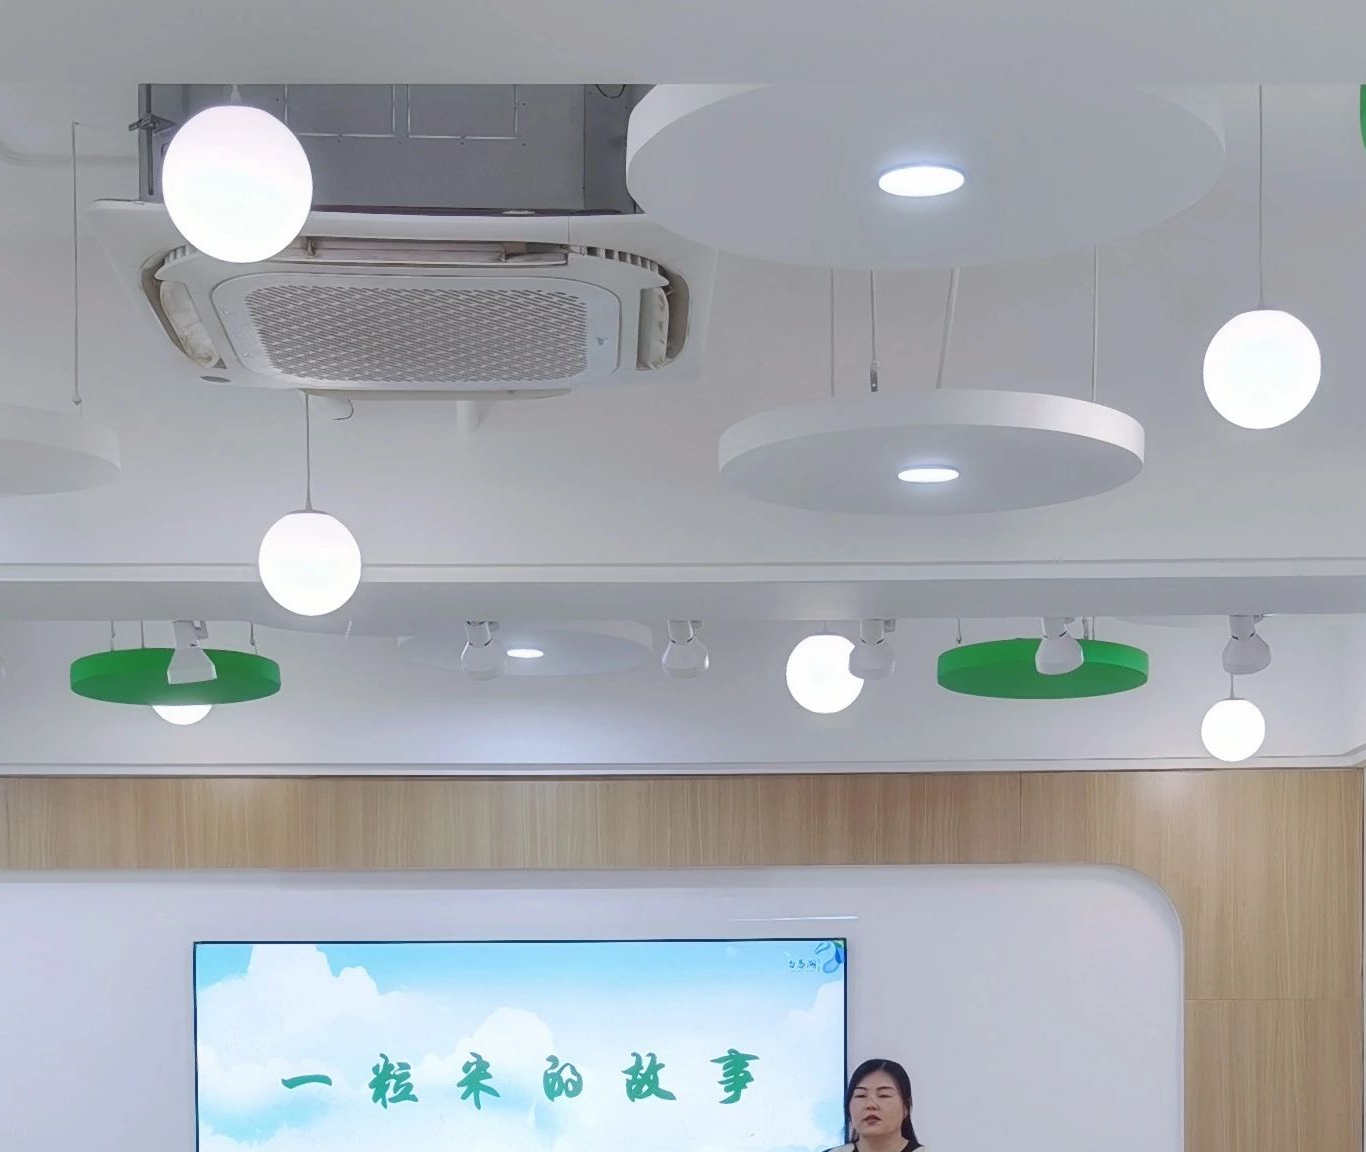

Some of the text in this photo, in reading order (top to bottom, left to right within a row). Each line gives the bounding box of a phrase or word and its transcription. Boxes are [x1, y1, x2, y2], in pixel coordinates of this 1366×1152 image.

[281, 1048, 760, 1111] 一粒米的故事
